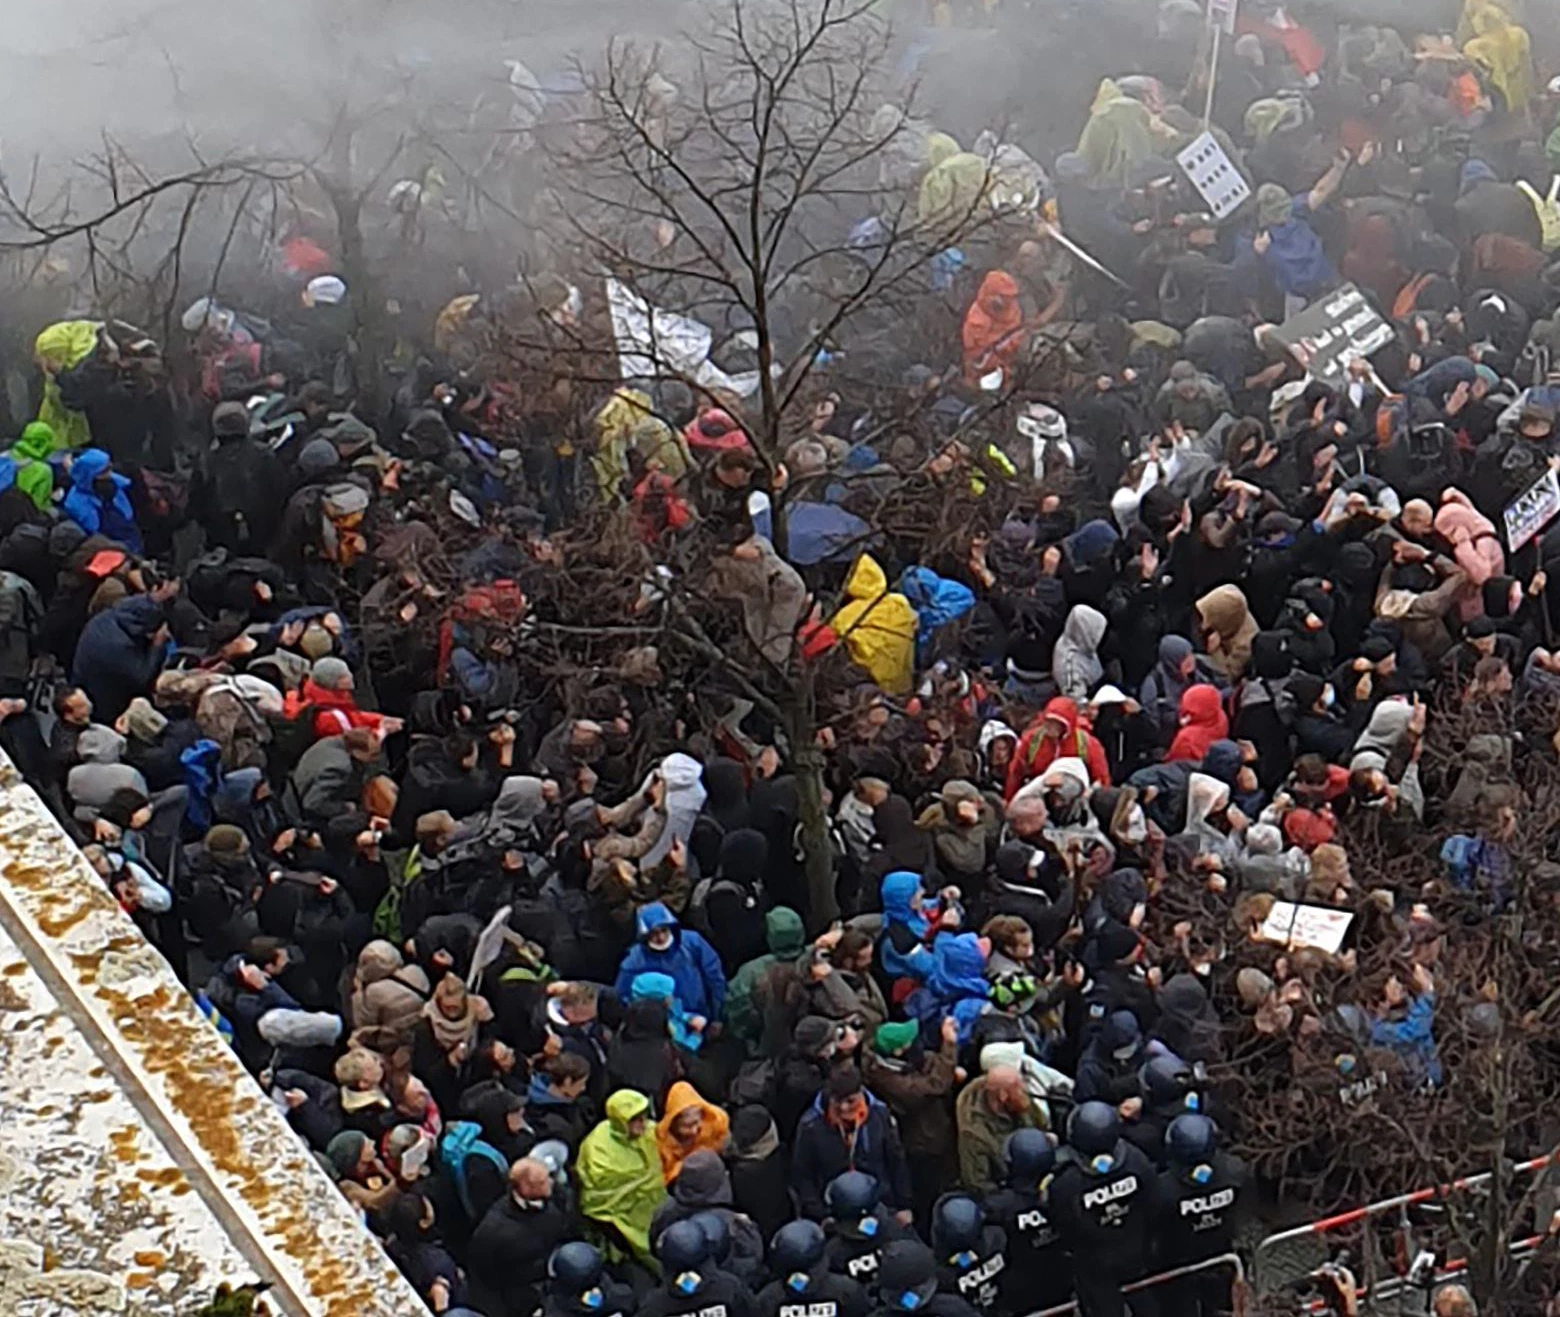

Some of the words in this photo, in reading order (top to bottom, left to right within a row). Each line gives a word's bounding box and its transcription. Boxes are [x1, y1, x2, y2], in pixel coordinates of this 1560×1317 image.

[1083, 1175, 1138, 1209] POLIZEI
[1180, 1188, 1234, 1216] POLIZEI
[959, 1253, 1004, 1292] POLIZEI
